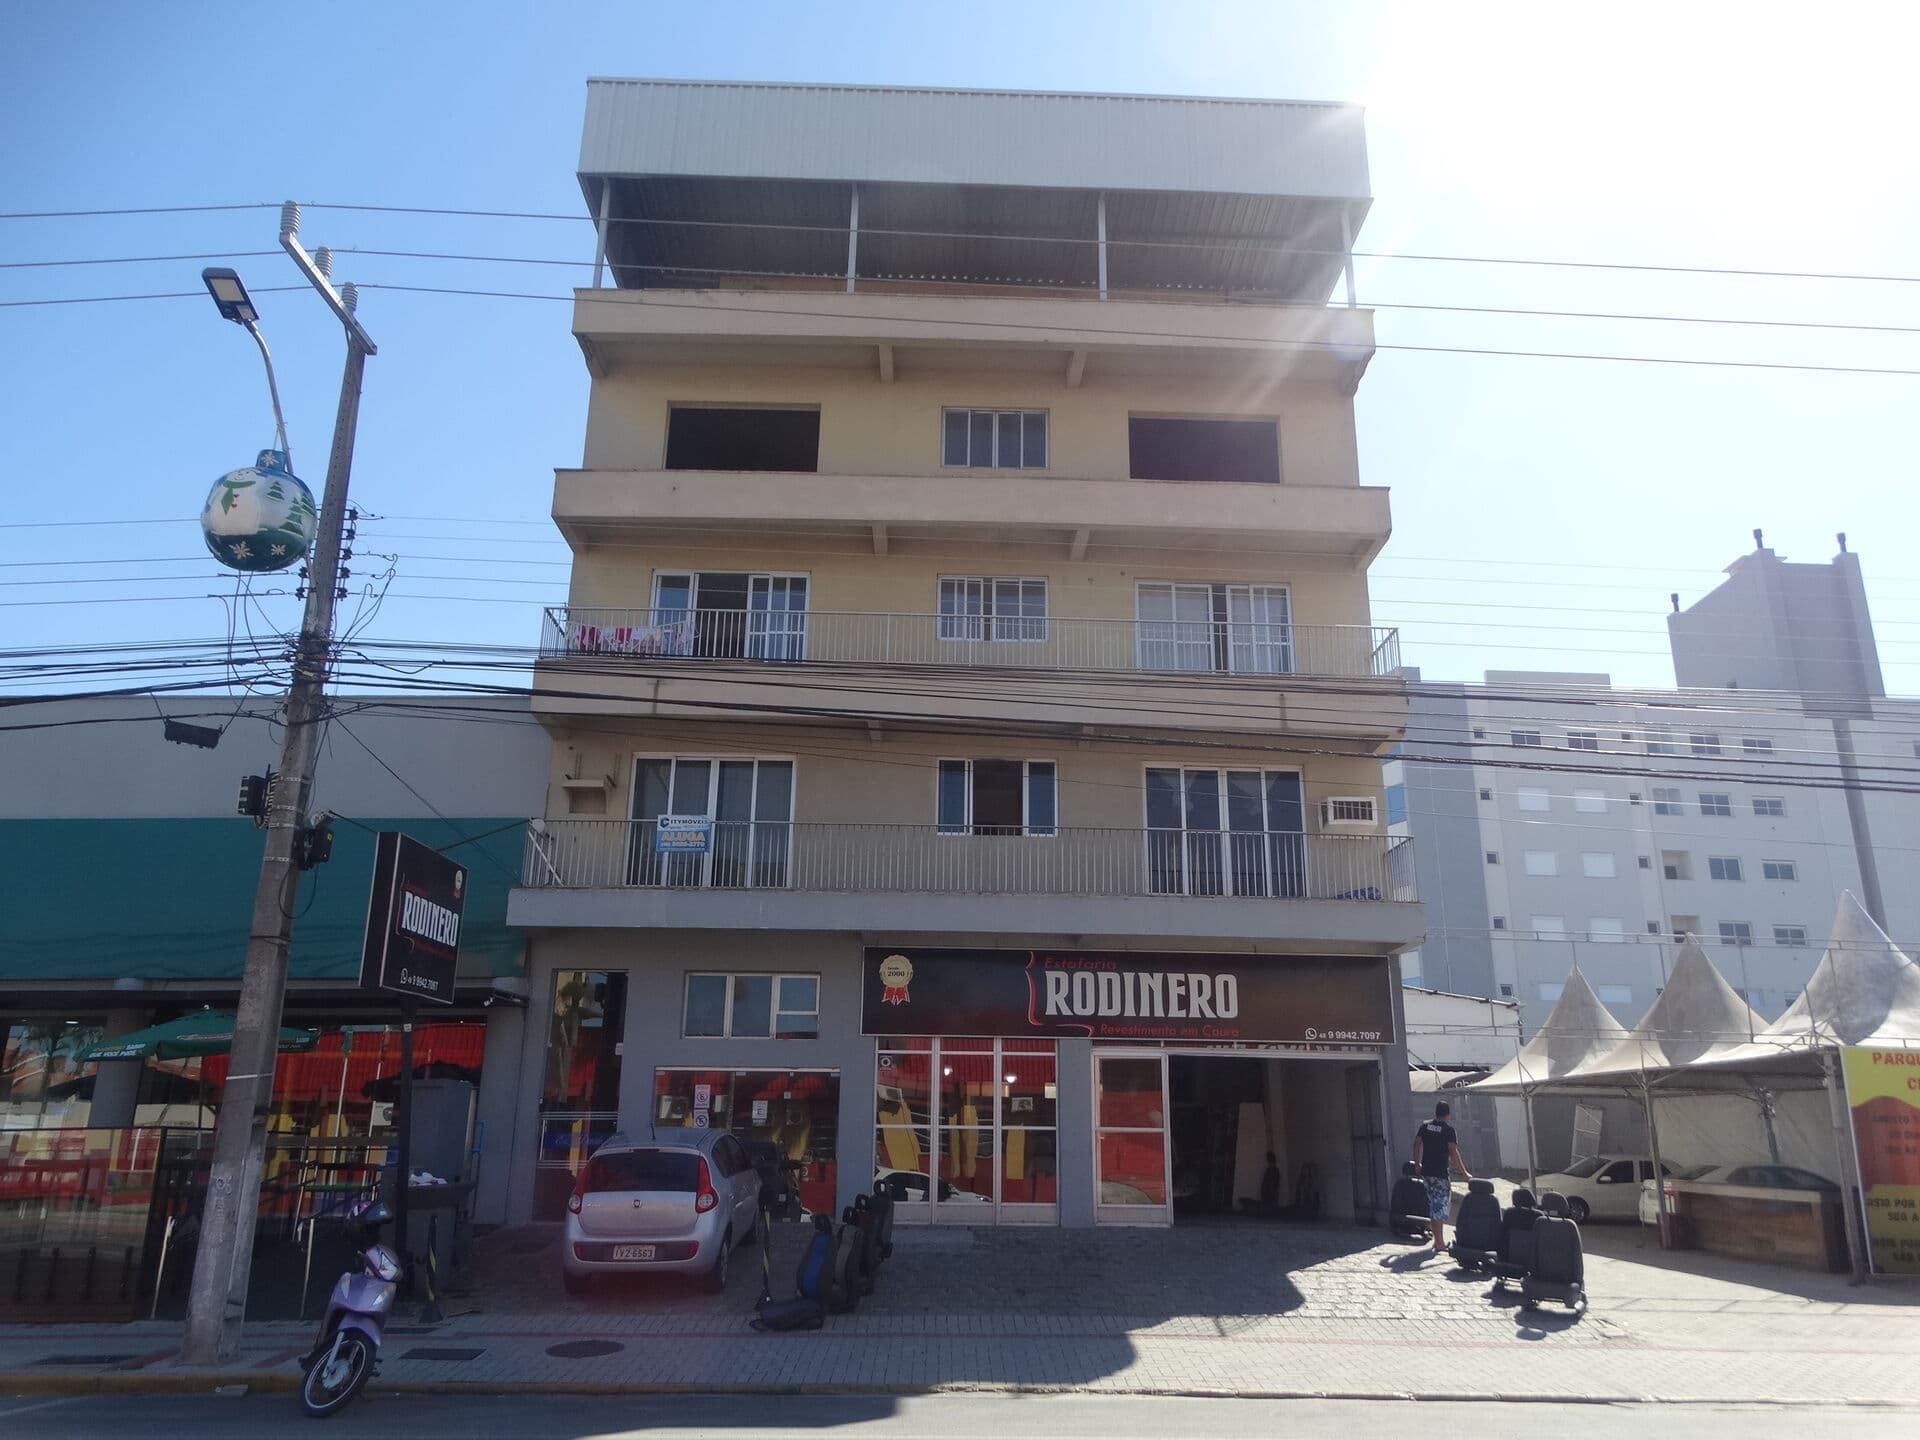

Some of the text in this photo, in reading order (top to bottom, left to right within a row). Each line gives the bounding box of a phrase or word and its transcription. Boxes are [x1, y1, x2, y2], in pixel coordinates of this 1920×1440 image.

[401, 891, 459, 947] RODINERO
[1045, 970, 1239, 1019] RODINERO
[1328, 1031, 1334, 1040] 9
[1335, 1031, 1381, 1040] 9942.7097
